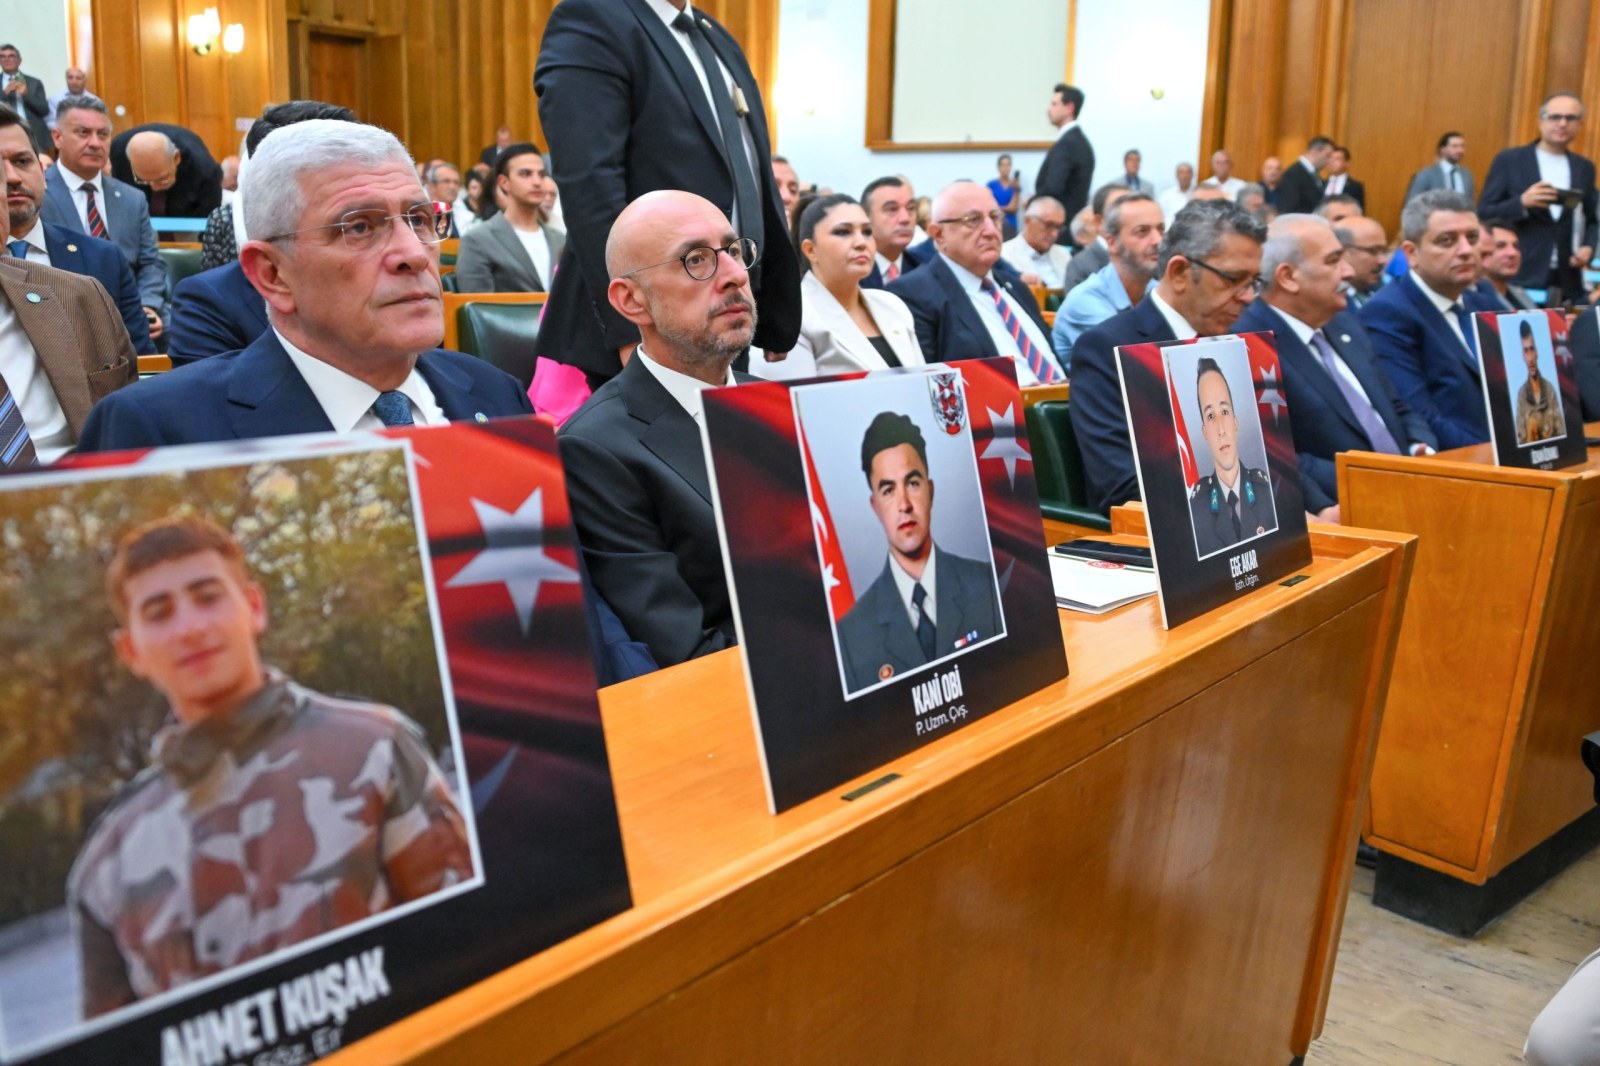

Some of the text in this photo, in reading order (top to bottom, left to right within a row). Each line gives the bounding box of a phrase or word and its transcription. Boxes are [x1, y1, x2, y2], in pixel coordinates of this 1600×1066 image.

[1230, 550, 1258, 578] EGE AKAR
[912, 664, 964, 716] KANİ OBİ
[916, 704, 968, 736] P. Uzm. Çvş.
[161, 946, 390, 1066] AHMET KUŞAK
